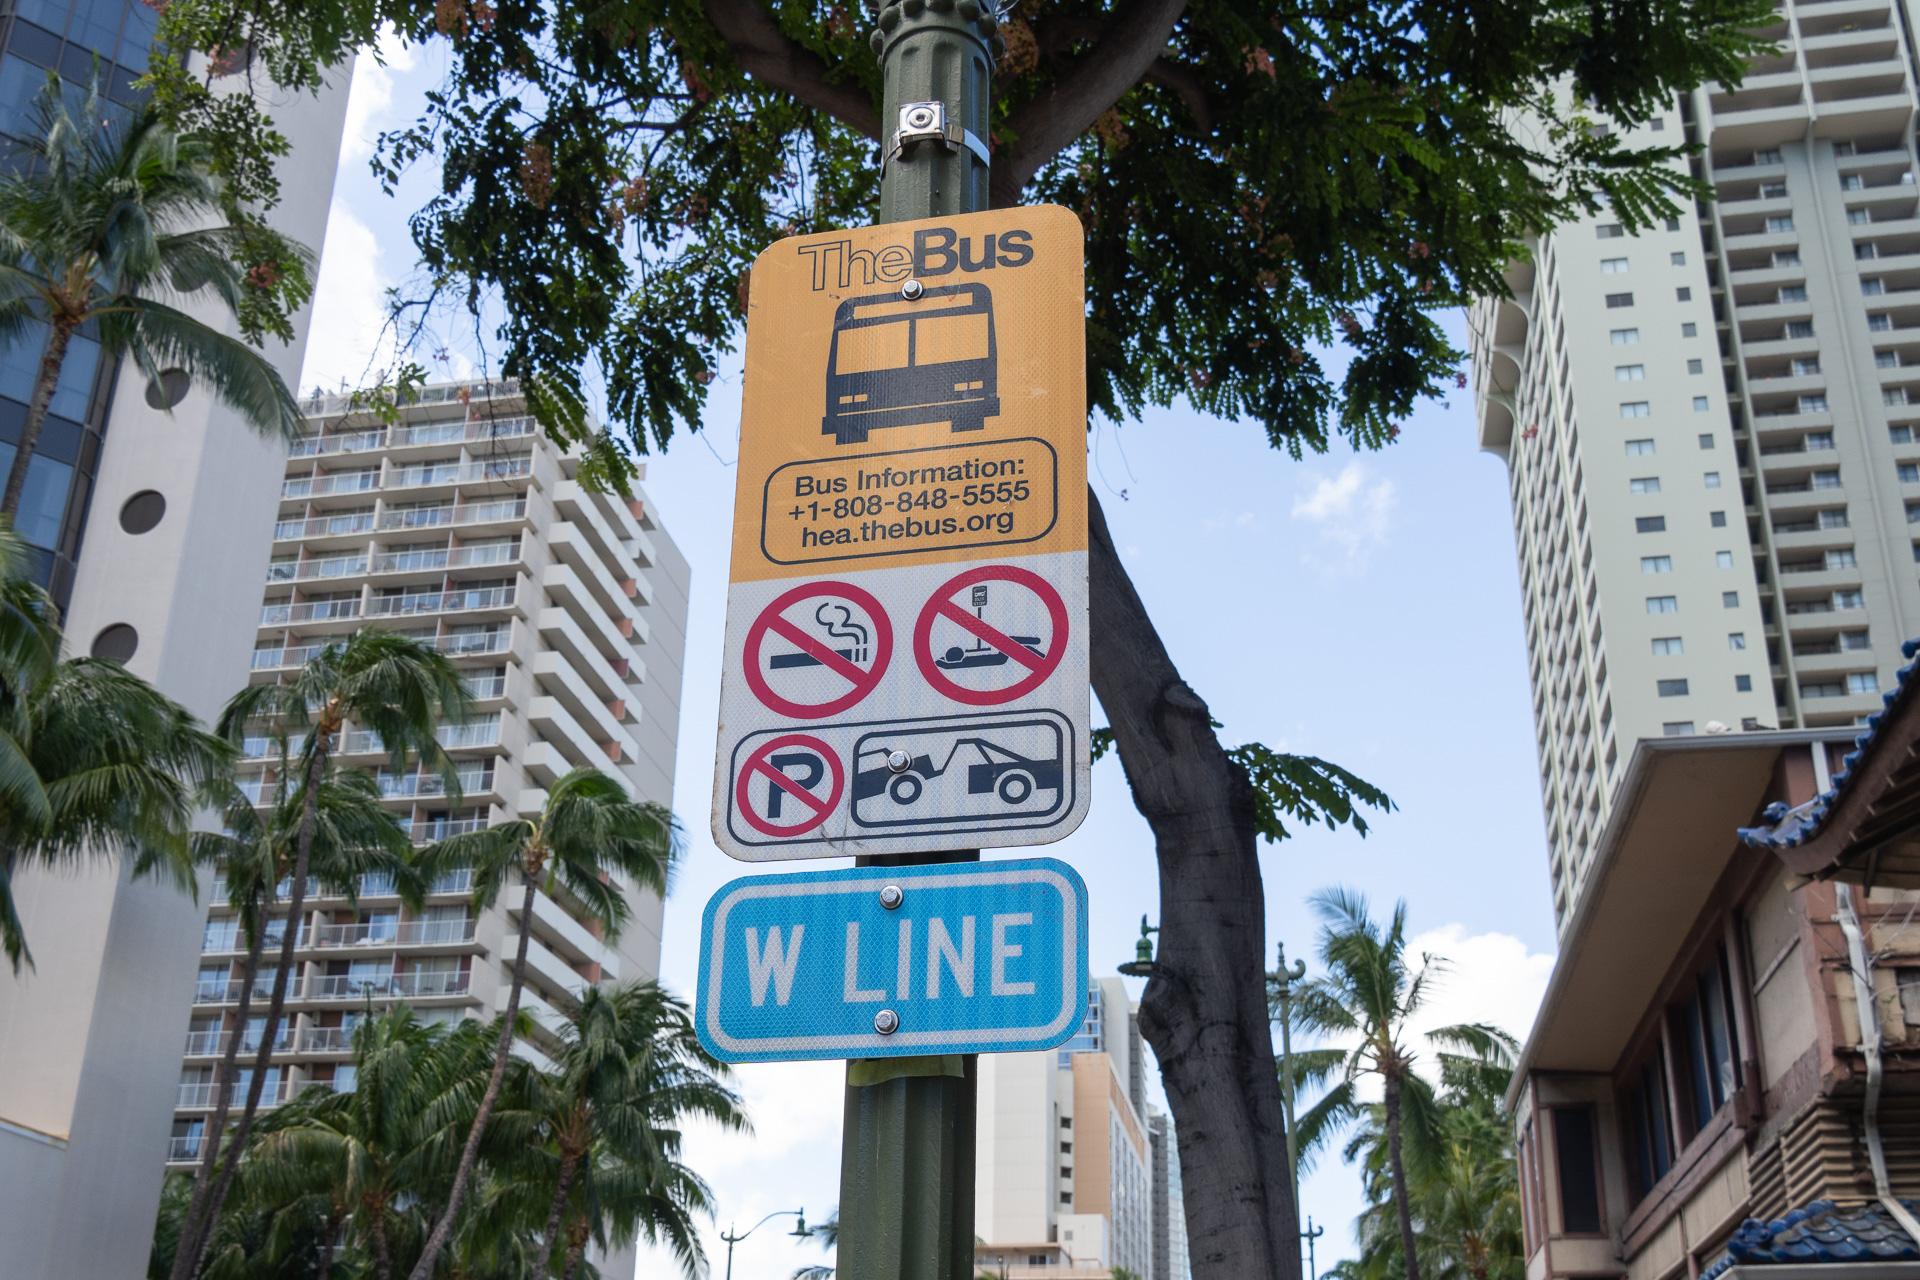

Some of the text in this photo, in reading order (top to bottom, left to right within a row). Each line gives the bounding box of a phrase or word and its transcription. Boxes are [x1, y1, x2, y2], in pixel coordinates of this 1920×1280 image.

[798, 227, 1034, 291] TheBus
[795, 458, 1025, 497] Bus Information:
[789, 480, 1030, 521] +1-808-848-5555
[802, 511, 1014, 548] hea.thebus.org
[745, 912, 1036, 1008] W LINE
